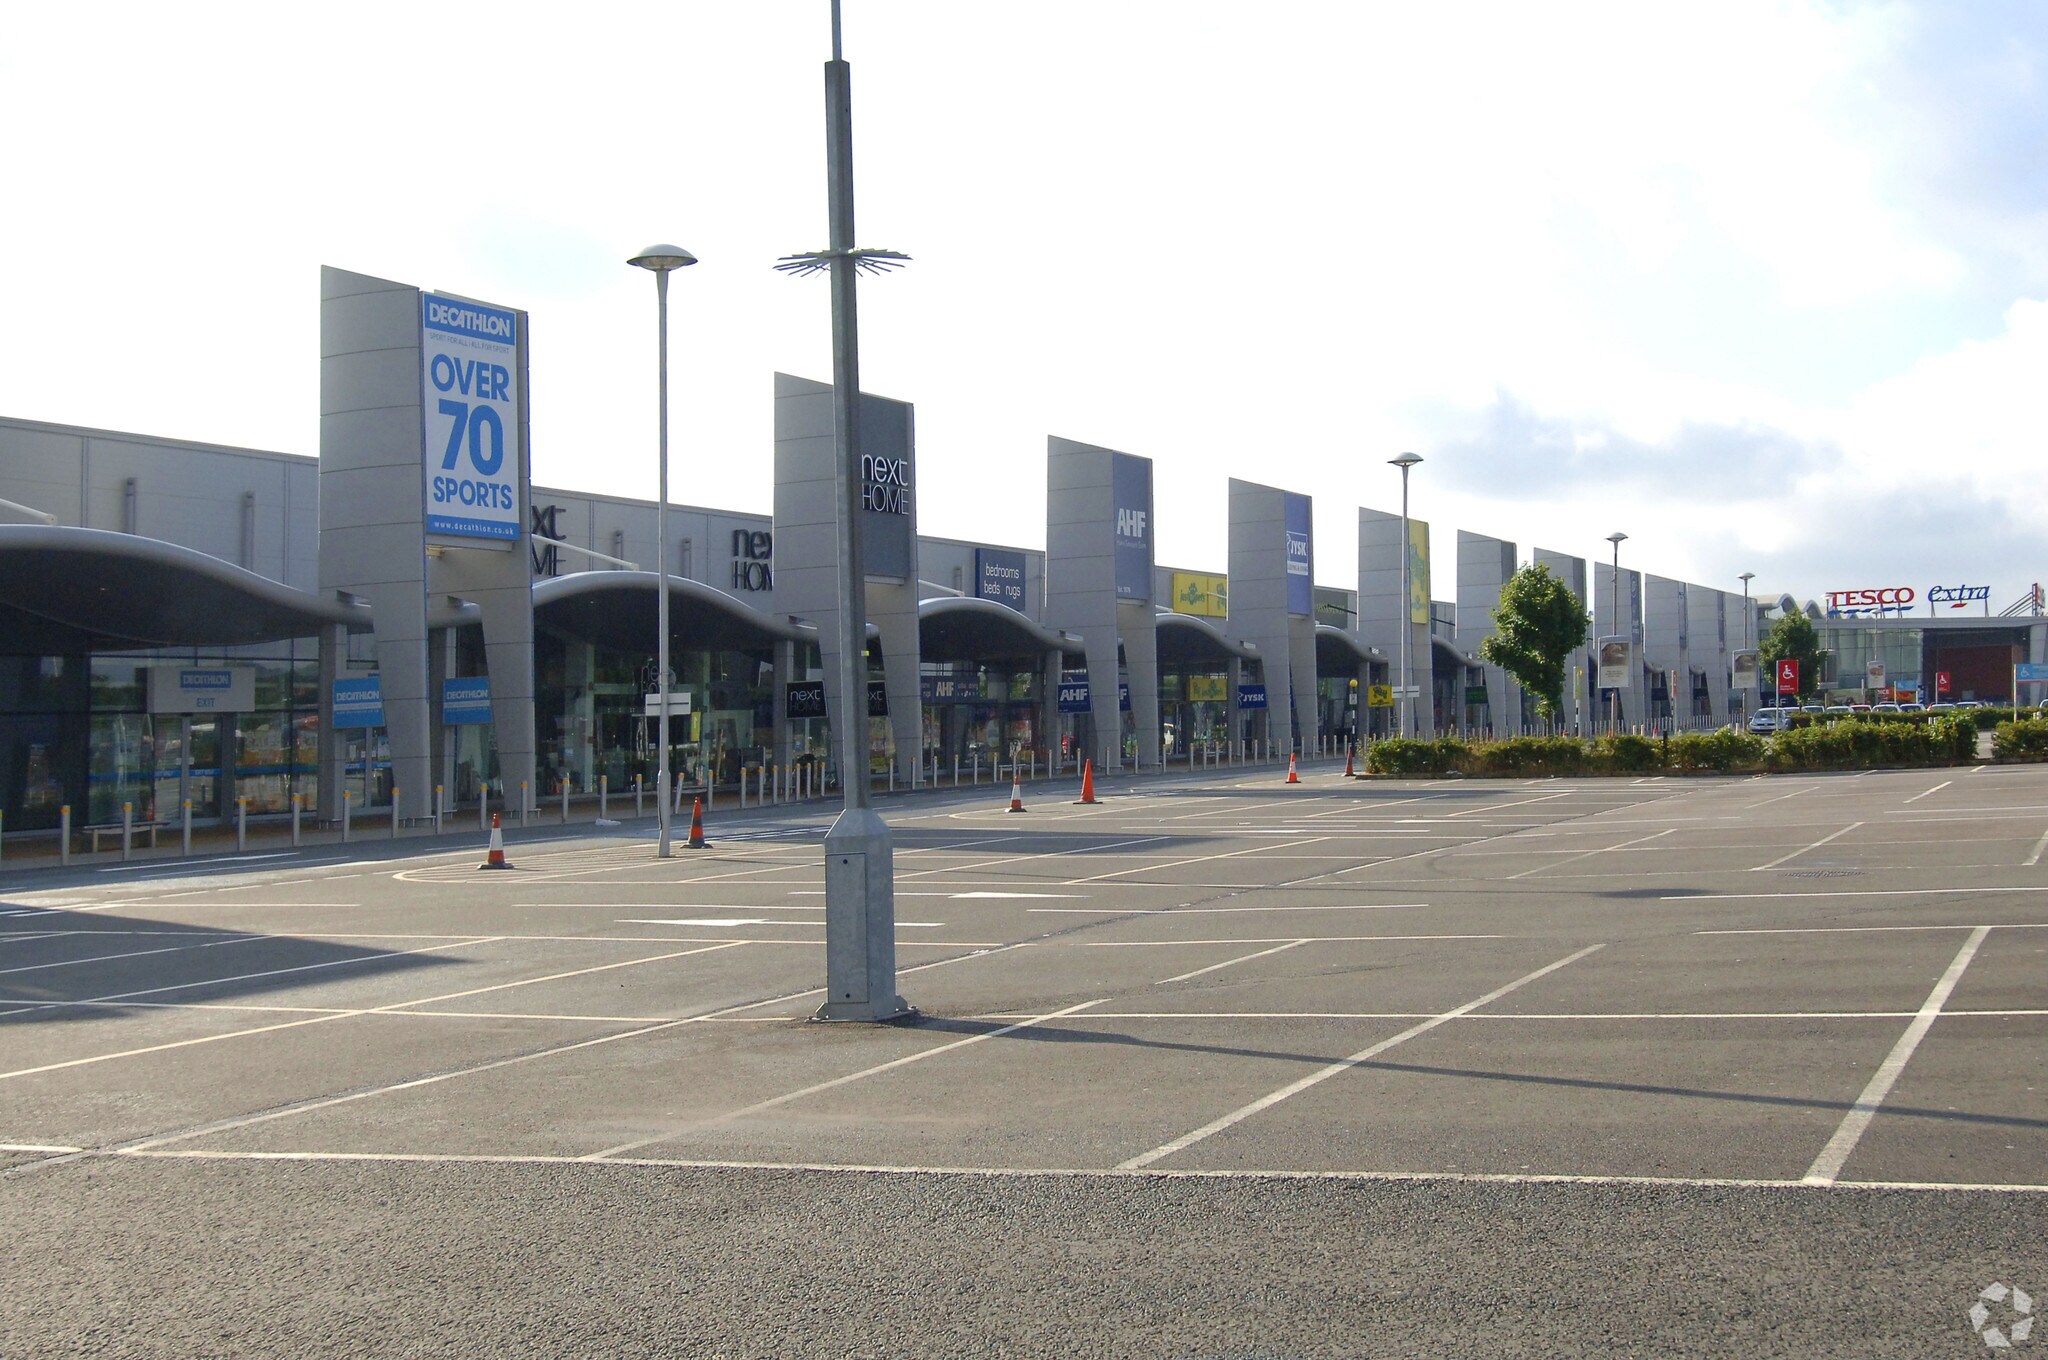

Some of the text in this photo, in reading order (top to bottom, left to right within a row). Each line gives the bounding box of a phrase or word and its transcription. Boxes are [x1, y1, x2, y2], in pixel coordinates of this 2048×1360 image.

[429, 302, 510, 338] DECATHLON
[430, 353, 510, 403] OVER
[438, 398, 504, 477] 70
[861, 453, 909, 487] next
[433, 476, 513, 510] SPORTS
[861, 482, 910, 515] HOME
[433, 521, 514, 536] www.decathlon.co.uk
[1116, 507, 1146, 538] AHF
[1290, 540, 1307, 556] JYSK
[985, 562, 1020, 579] bedrooms
[983, 579, 1021, 600] beds rugs
[1832, 584, 1991, 607] TESCO extra
[182, 674, 230, 685] DECATHLON
[336, 690, 380, 701] DECATHLON
[446, 689, 489, 700] DECATHLON
[790, 689, 821, 701] next
[935, 681, 954, 697] AHF
[1059, 688, 1088, 702] AHF
[195, 697, 216, 708] EXIT
[1242, 693, 1265, 702] JYSK
